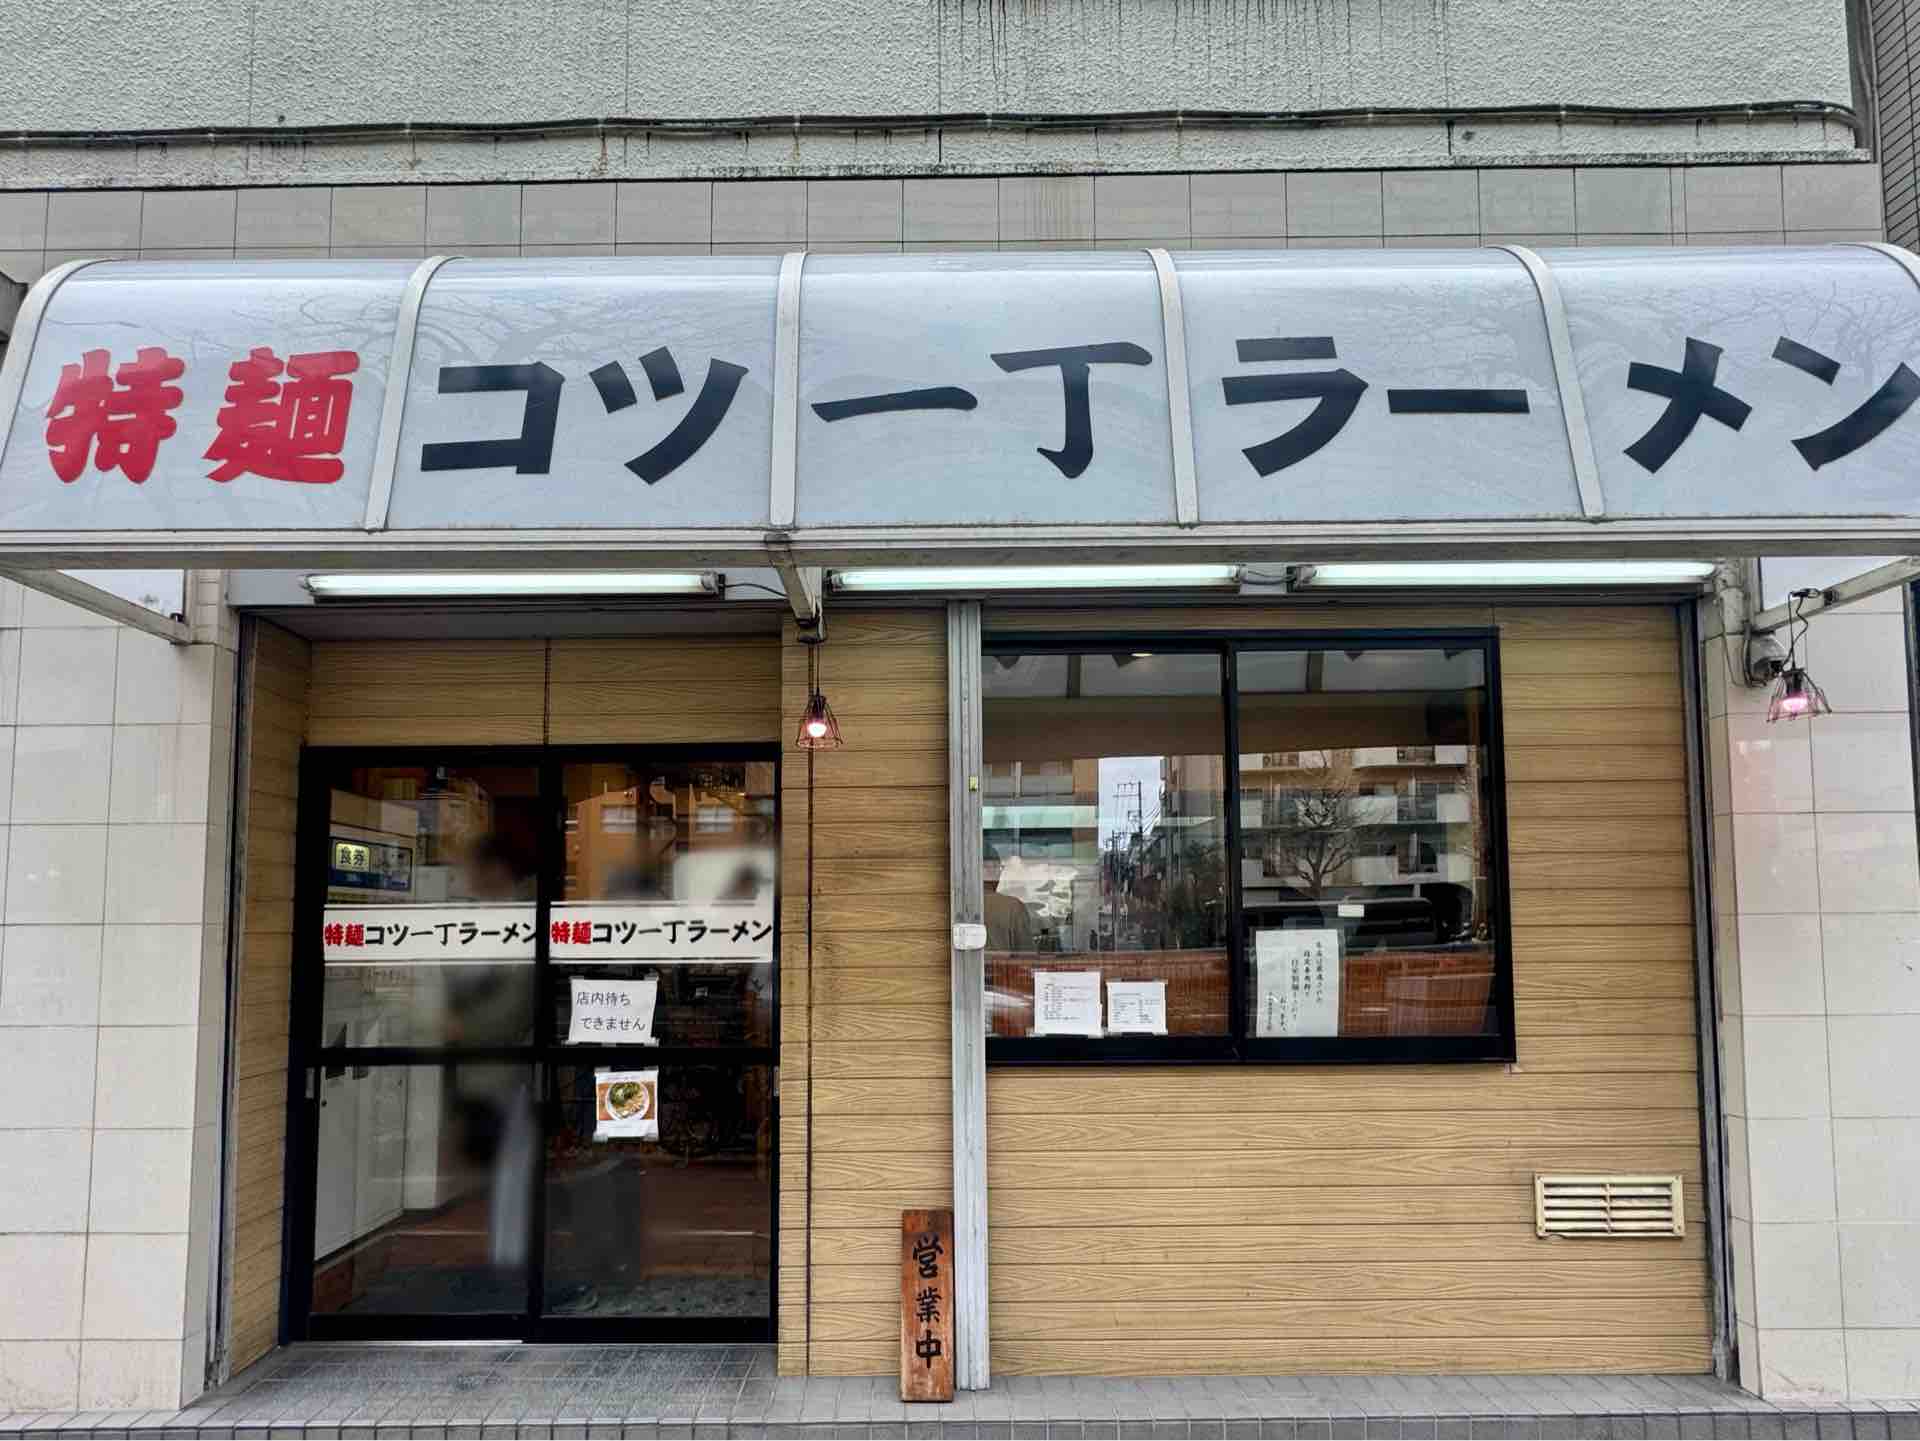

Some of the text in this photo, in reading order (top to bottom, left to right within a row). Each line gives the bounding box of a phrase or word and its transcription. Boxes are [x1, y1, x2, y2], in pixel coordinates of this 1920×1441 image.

[576, 991, 631, 1007] 店内待ち
[580, 1017, 646, 1031] できません
[913, 1231, 944, 1369] 営業中
